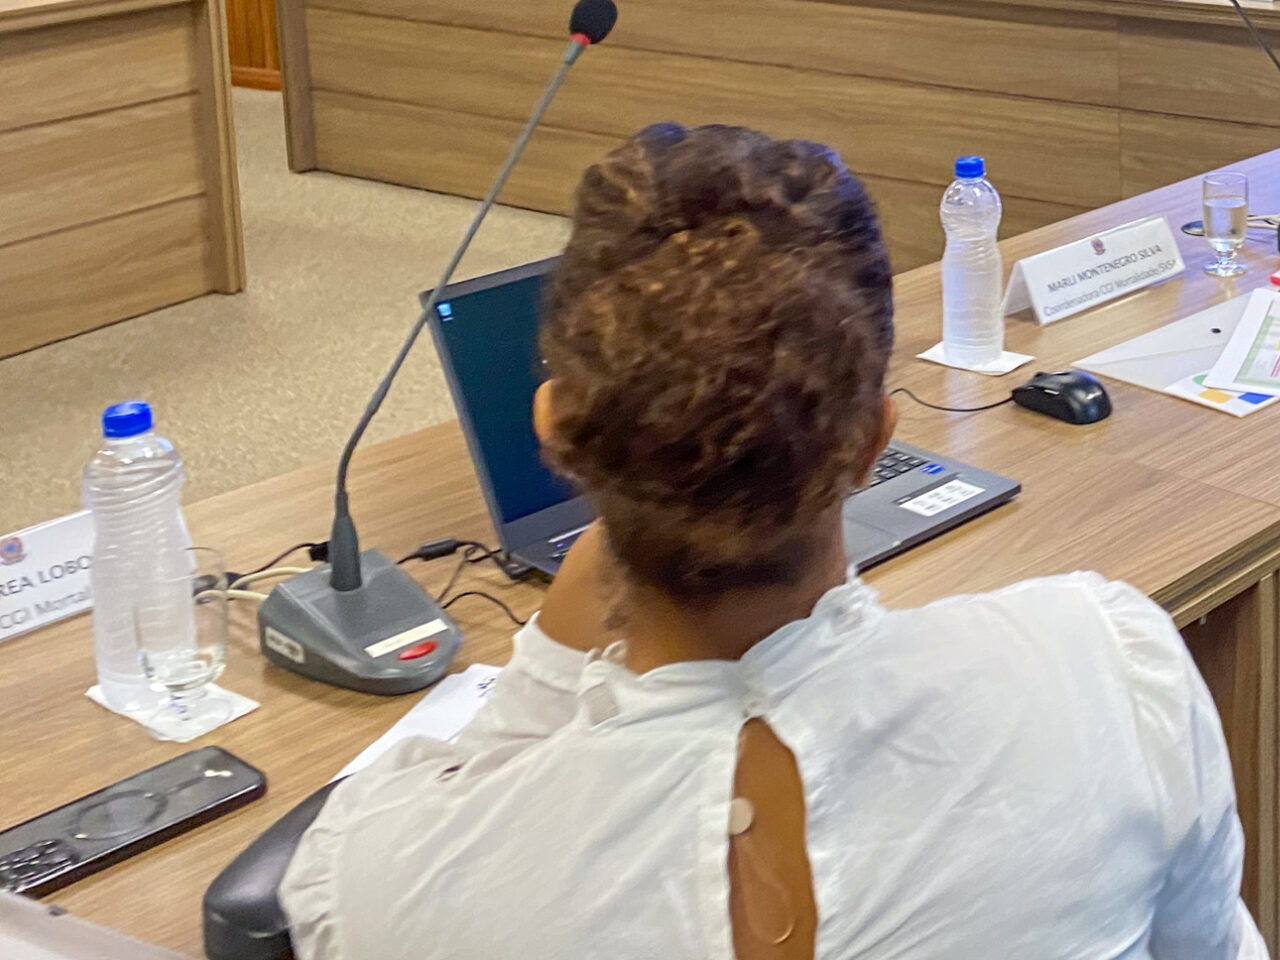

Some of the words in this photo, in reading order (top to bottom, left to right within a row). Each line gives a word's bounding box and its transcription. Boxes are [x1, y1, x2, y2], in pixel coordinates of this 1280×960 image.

[1077, 253, 1138, 283] MONTENEGRO
[1137, 244, 1162, 261] SILVA
[37, 554, 92, 584] LOBO
